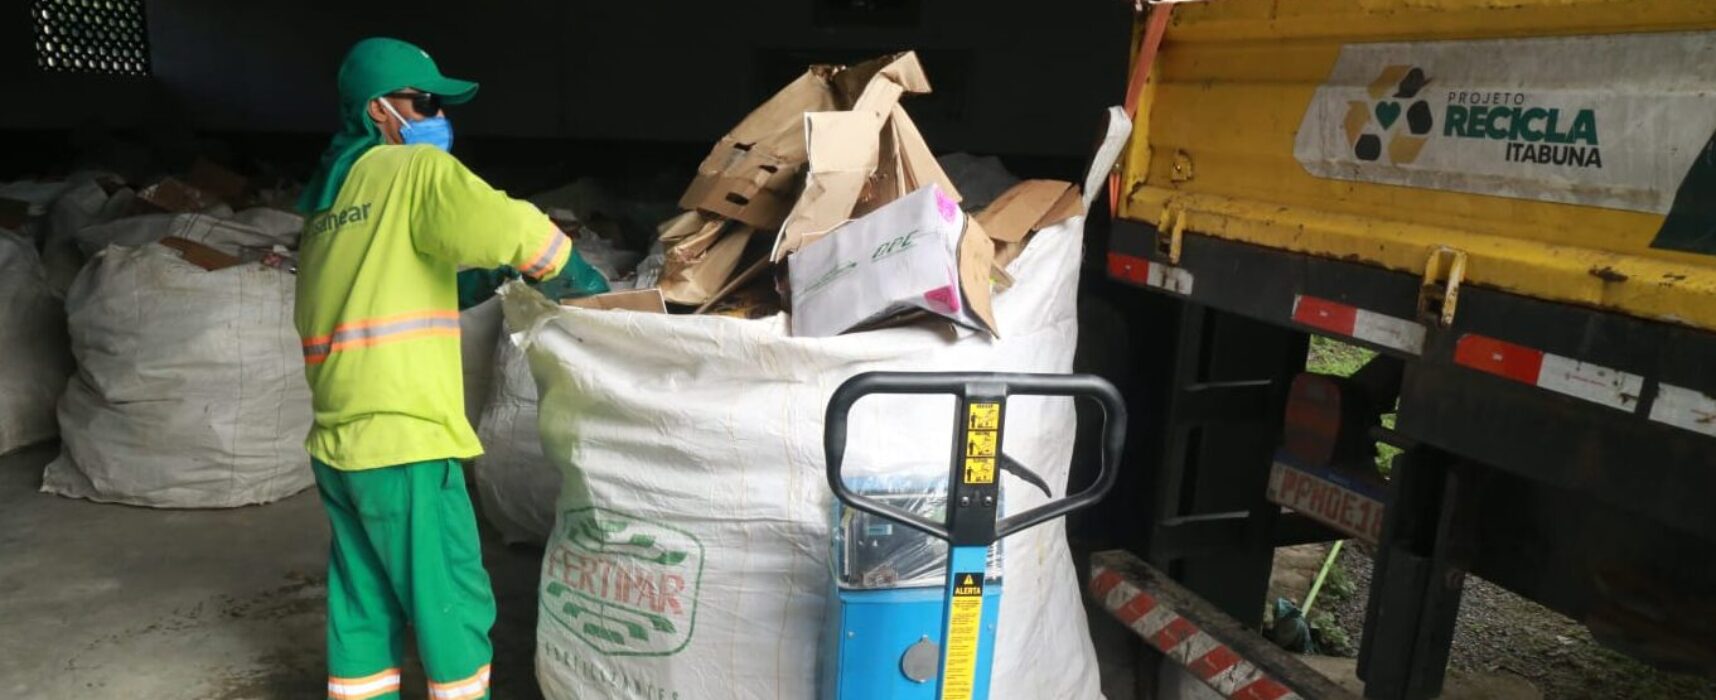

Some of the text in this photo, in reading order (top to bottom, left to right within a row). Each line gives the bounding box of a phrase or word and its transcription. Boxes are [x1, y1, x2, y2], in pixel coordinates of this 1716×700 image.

[1447, 92, 1526, 106] PROJETO
[1443, 105, 1599, 146] RECICLA
[1505, 142, 1603, 169] ITABUNA
[955, 586, 982, 596] ALERTA
